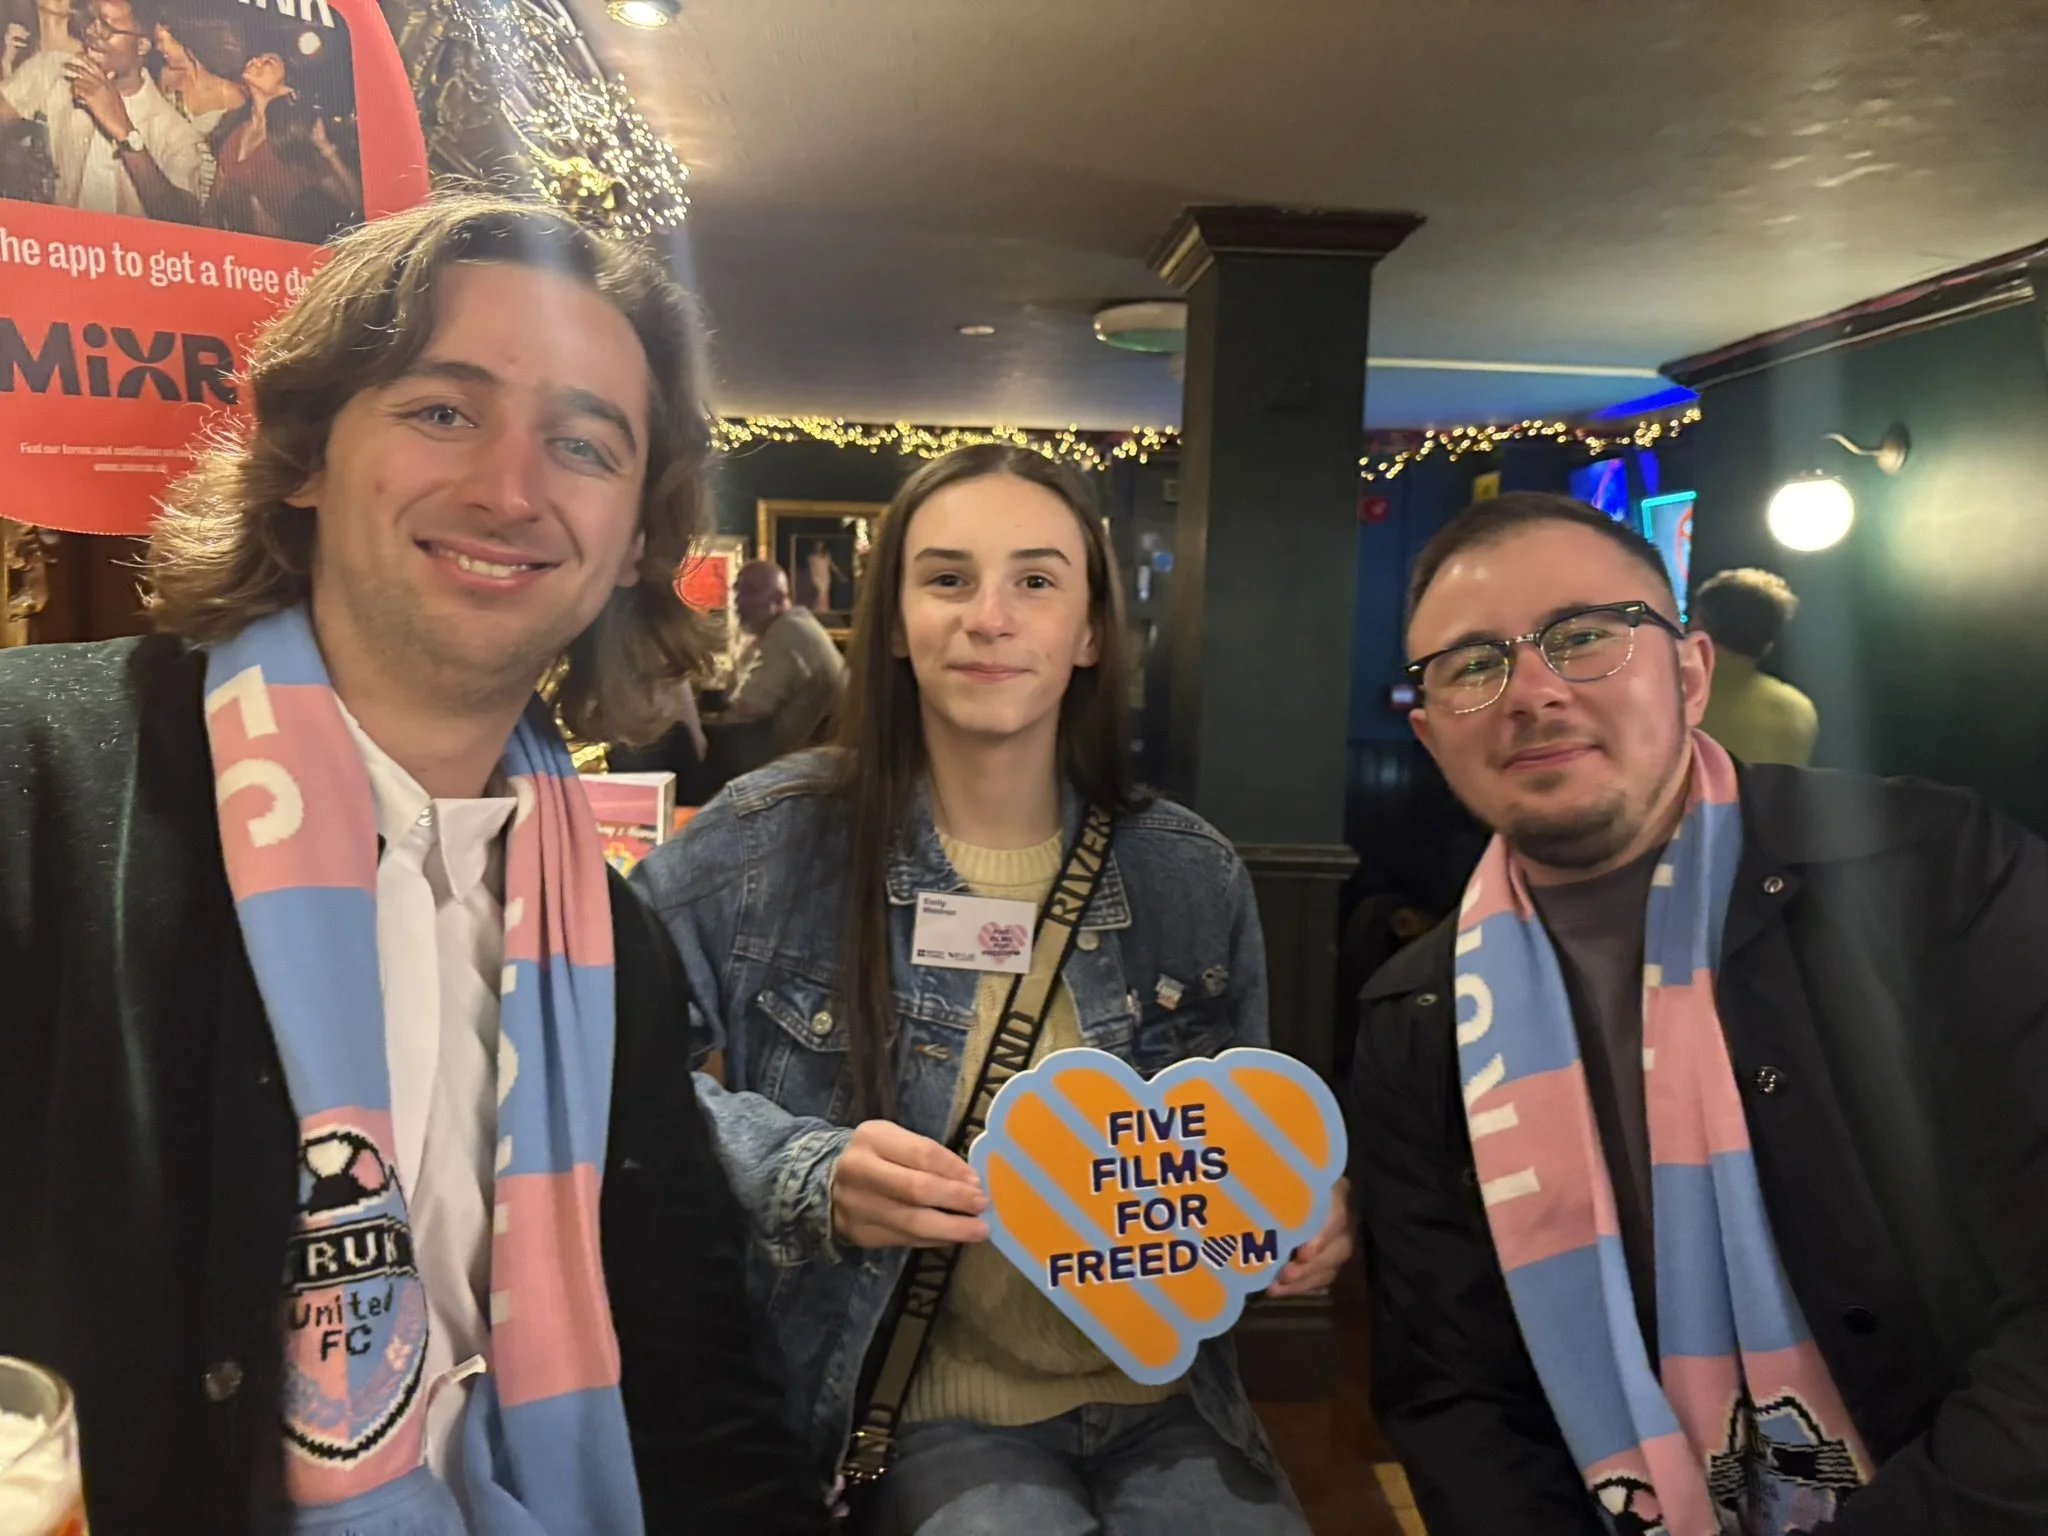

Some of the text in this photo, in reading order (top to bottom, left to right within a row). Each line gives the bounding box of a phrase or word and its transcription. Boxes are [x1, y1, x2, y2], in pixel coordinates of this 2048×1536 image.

[0, 227, 41, 266] he
[48, 241, 106, 280] app
[112, 242, 143, 278] to
[149, 249, 195, 287] get
[200, 261, 219, 287] a
[223, 255, 280, 294] free
[1048, 802, 1114, 926] RIVER
[1108, 1103, 1207, 1148] FIVE
[1090, 1147, 1229, 1195] FILMS
[1115, 1194, 1208, 1237] FOR
[306, 1231, 399, 1277] RUK
[903, 1246, 956, 1320] RIV
[320, 1323, 373, 1361] FC
